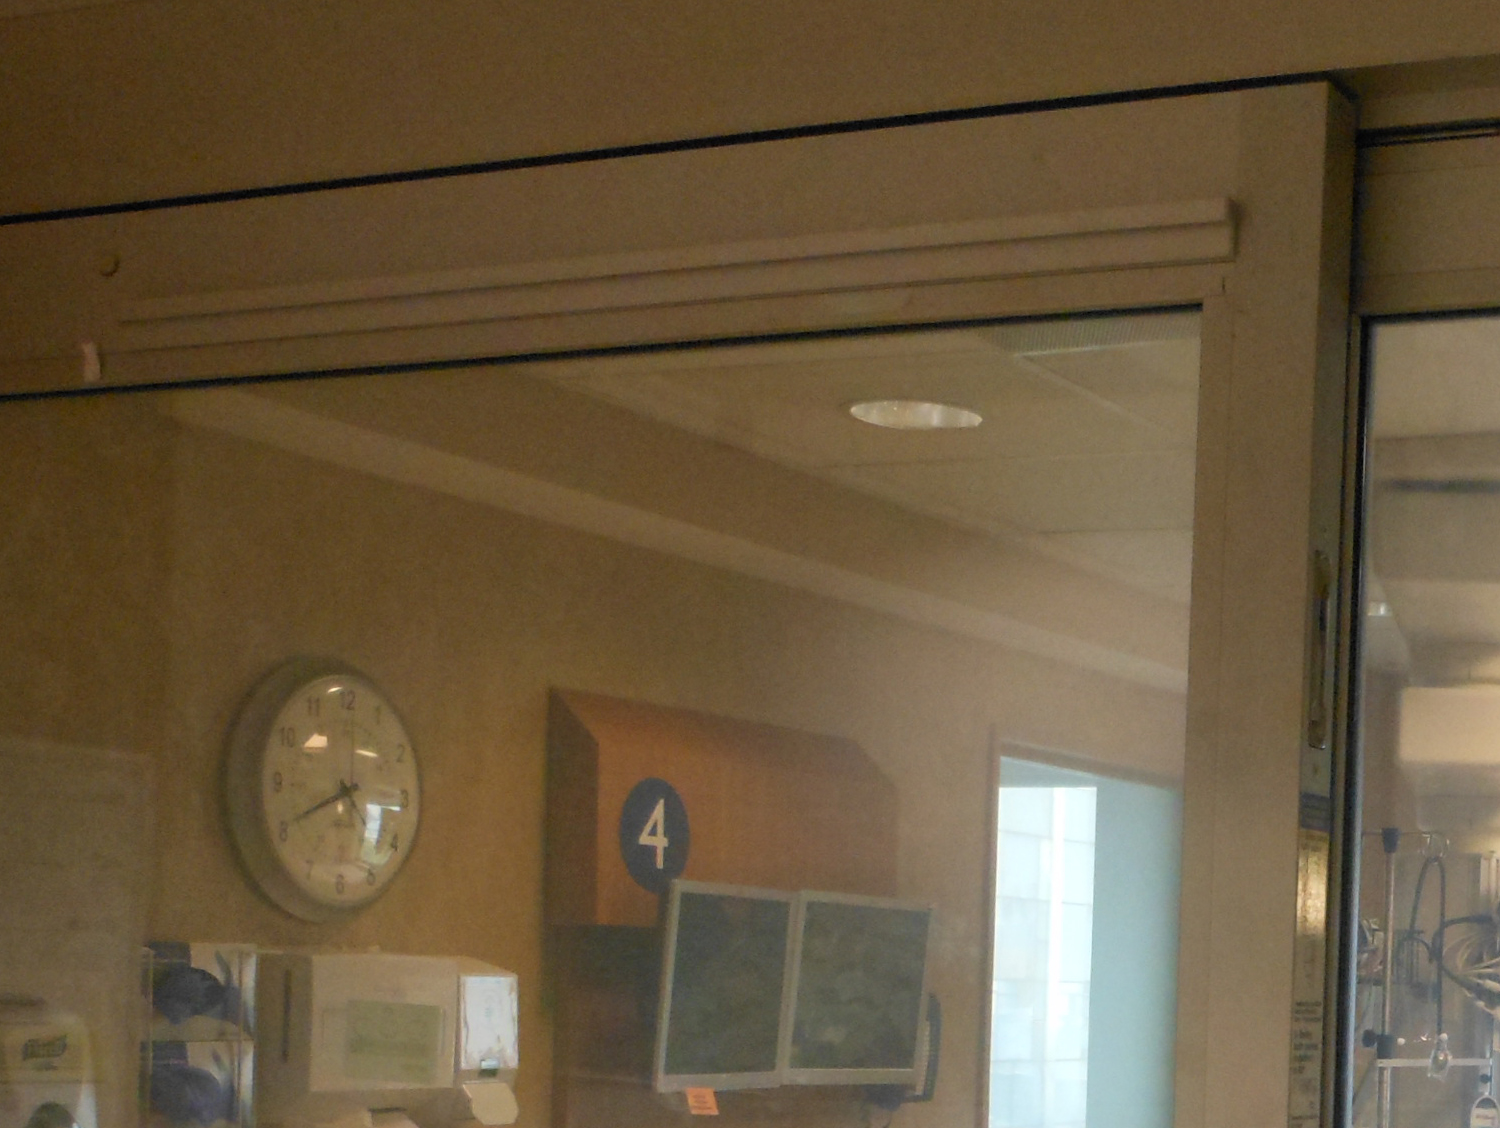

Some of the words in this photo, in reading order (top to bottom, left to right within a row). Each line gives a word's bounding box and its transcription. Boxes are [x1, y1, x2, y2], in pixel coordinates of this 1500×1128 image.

[307, 696, 320, 716] 11
[340, 690, 356, 711] 12
[281, 727, 296, 747] 10
[396, 744, 406, 763] 2
[273, 772, 283, 792] 9
[279, 821, 289, 842] 8
[639, 799, 669, 869] 4
[390, 833, 399, 853] 4
[306, 860, 314, 880] 7
[335, 874, 345, 895] 6
